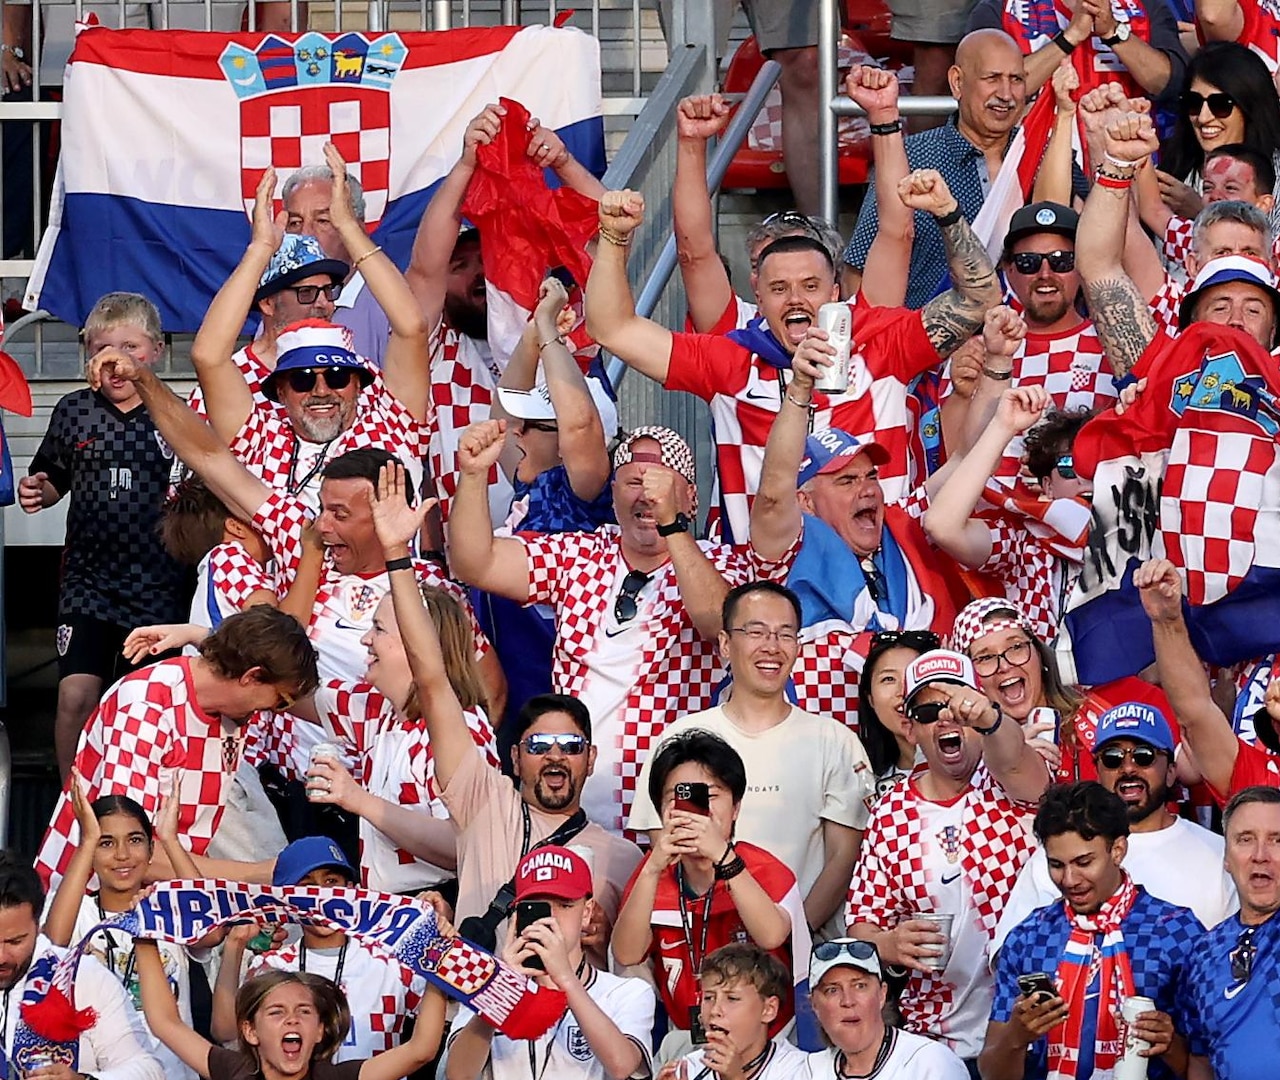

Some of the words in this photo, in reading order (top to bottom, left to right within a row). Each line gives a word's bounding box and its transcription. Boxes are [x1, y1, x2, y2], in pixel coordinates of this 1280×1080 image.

[917, 658, 958, 674] CROATIA
[1101, 704, 1156, 731] CROATIA
[521, 852, 575, 880] CANADA
[662, 957, 684, 1001] 7
